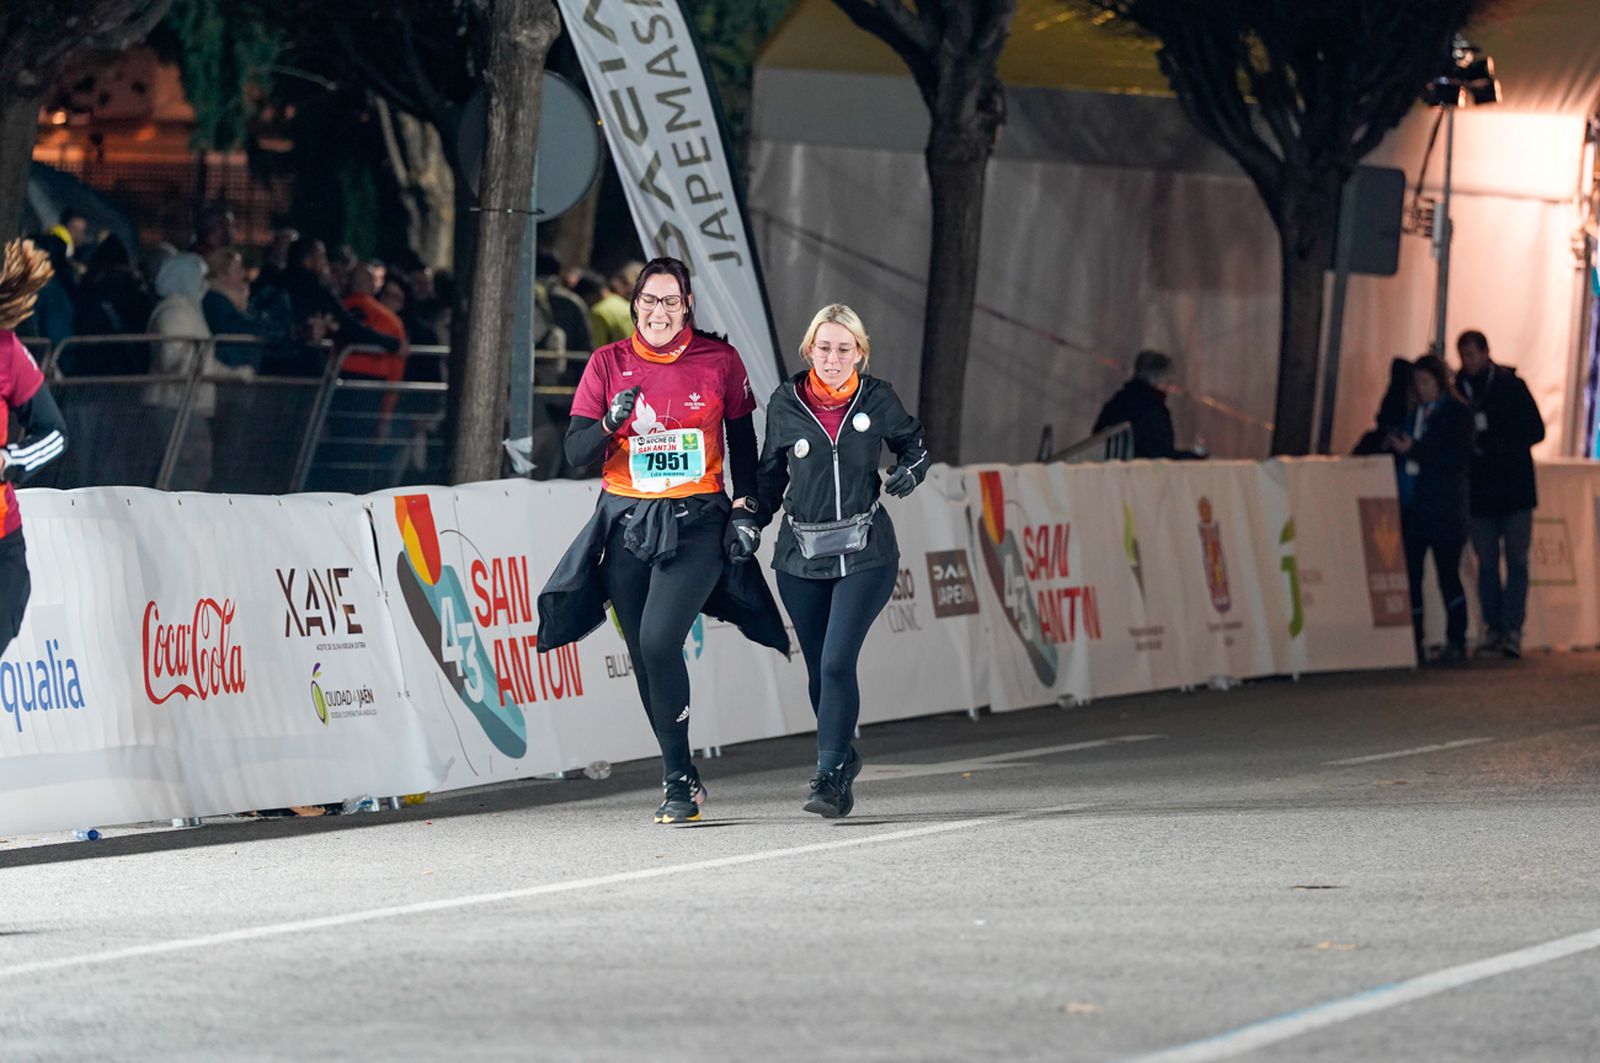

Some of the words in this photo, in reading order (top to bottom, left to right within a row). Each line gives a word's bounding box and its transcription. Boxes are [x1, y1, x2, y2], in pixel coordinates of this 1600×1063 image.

[645, 452, 689, 471] 7951
[1023, 522, 1070, 581] SAN
[276, 567, 363, 637] XAVE
[471, 555, 532, 628] SAN
[441, 596, 484, 703] 43
[325, 689, 352, 707] CIUDAD
